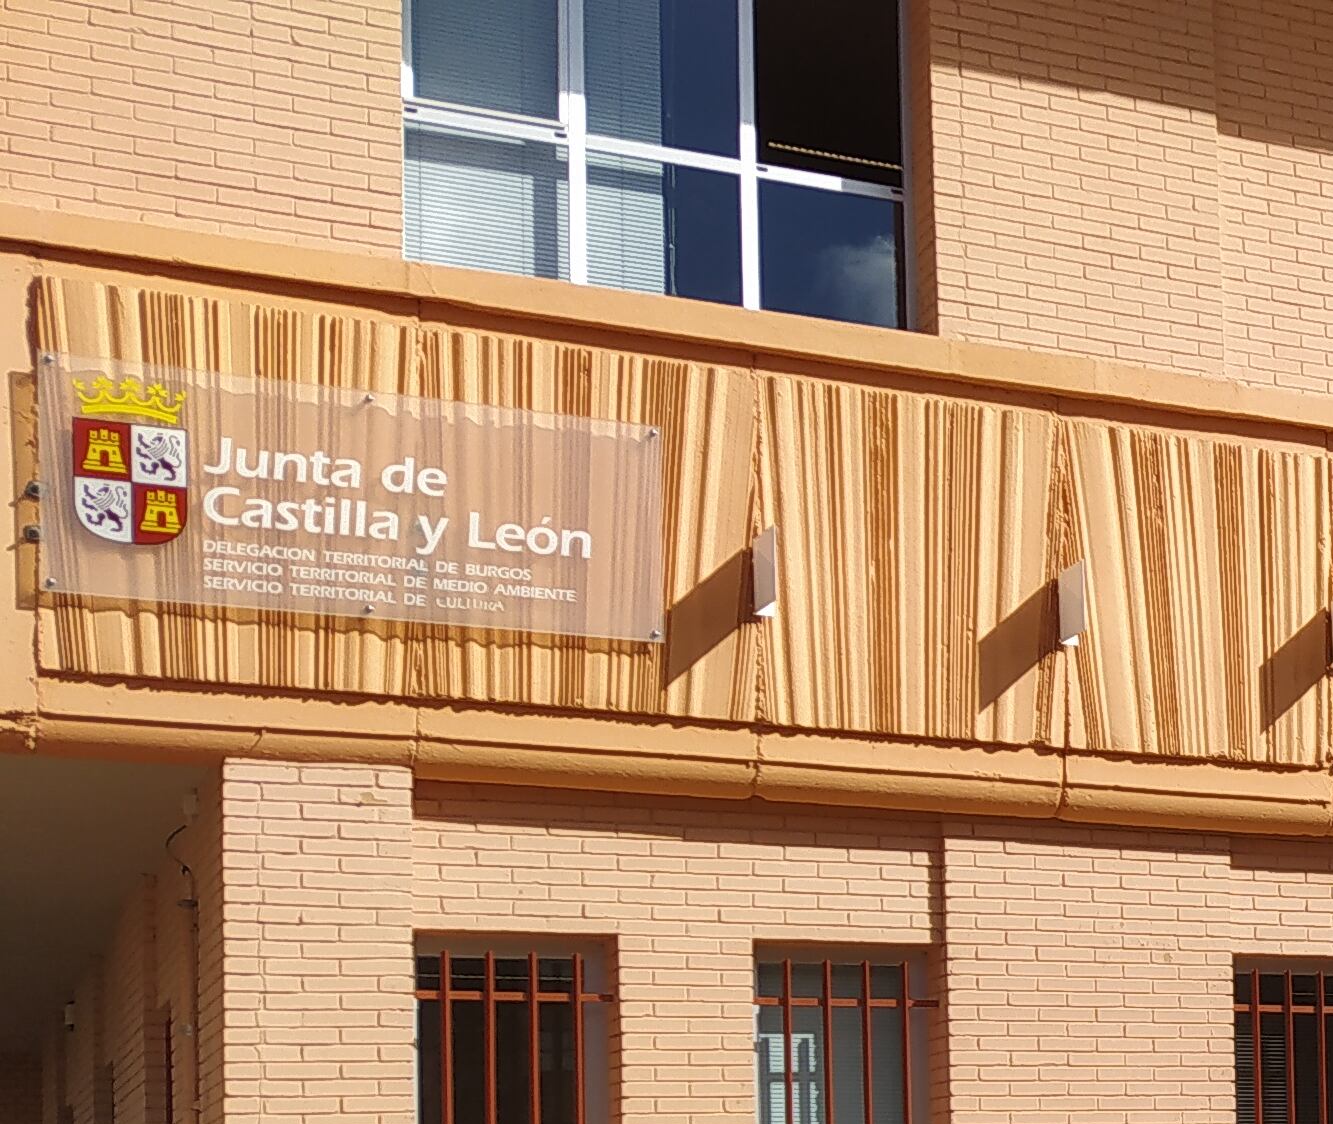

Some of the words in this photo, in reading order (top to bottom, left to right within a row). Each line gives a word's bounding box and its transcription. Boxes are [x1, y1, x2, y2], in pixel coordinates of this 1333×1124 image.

[202, 436, 362, 489] Junta
[381, 456, 448, 497] de
[202, 486, 399, 541] Castilla
[415, 514, 450, 556] y
[467, 511, 592, 559] León
[202, 539, 316, 562] DELEGACION
[323, 550, 429, 572] TERRITORIAL
[435, 560, 460, 575] DE
[464, 563, 533, 582] BURGOS
[202, 557, 284, 577] SERVICIO
[288, 565, 397, 587] TERRITORIAL
[403, 575, 429, 589] DE
[432, 578, 488, 594] MEDIO
[493, 583, 578, 602] AMBIENTE
[202, 575, 284, 595] SERVICIO
[288, 583, 397, 604] TERRITORIAL
[403, 592, 428, 607] DE
